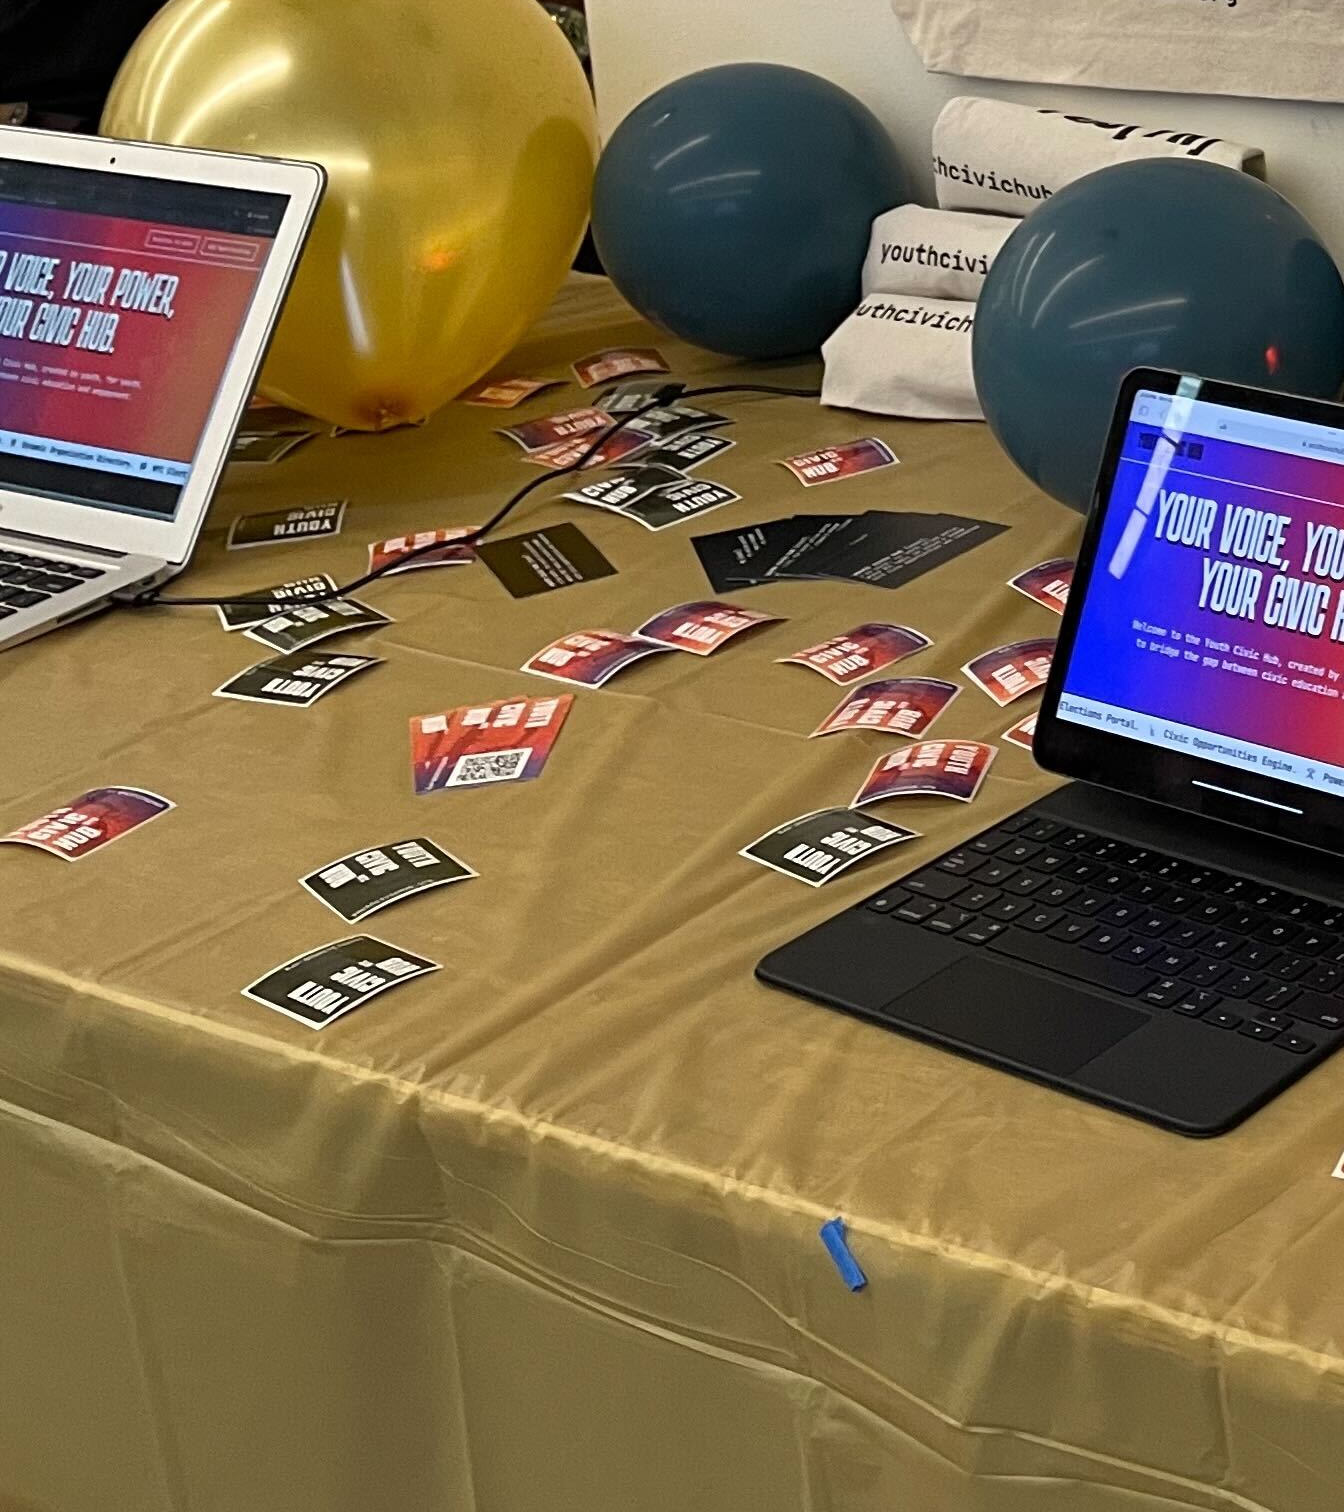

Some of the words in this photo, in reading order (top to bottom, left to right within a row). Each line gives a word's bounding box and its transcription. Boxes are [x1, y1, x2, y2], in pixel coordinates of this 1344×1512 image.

[4, 252, 61, 300] VOICE,
[63, 261, 115, 306] YOUR
[110, 268, 179, 319] POWER,
[29, 302, 82, 346] CIVIC
[1155, 489, 1218, 551] YOUR
[1219, 503, 1292, 572] VOICE,
[1198, 557, 1263, 620] YOUR
[1263, 574, 1331, 637] CIVIC
